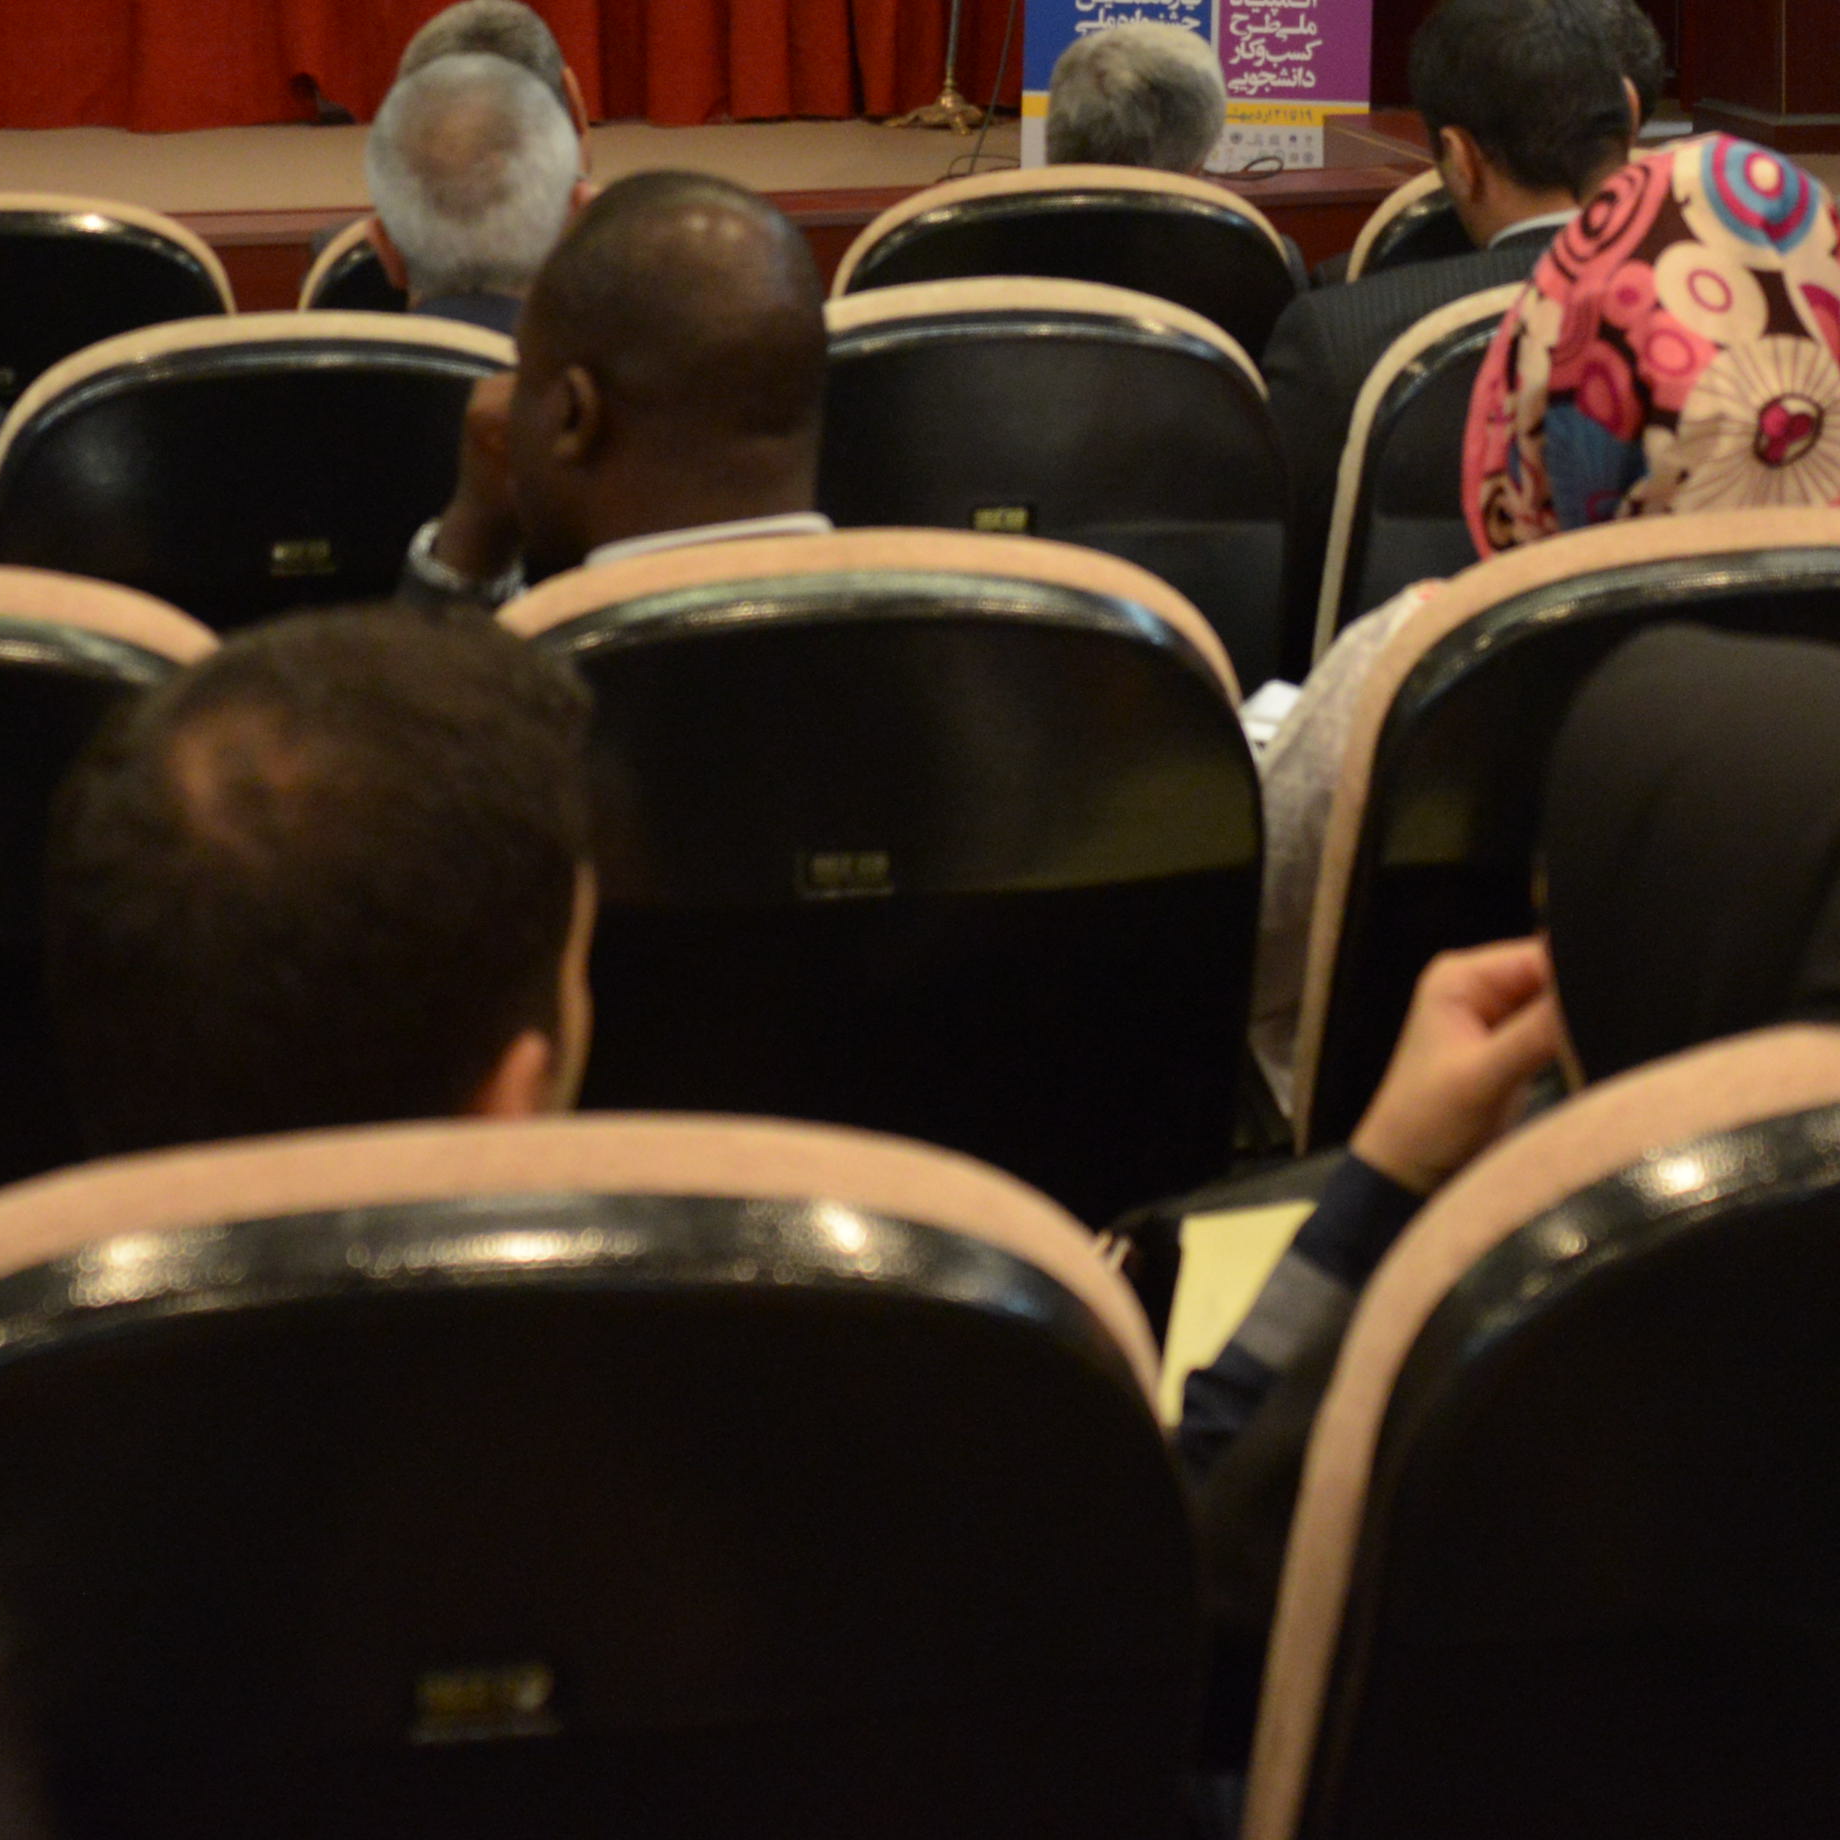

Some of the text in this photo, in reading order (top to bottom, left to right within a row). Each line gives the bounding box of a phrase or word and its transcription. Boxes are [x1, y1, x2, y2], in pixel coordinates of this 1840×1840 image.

[1229, 11, 1318, 42] ملی طرح
[1227, 66, 1317, 97] دانشجویی
